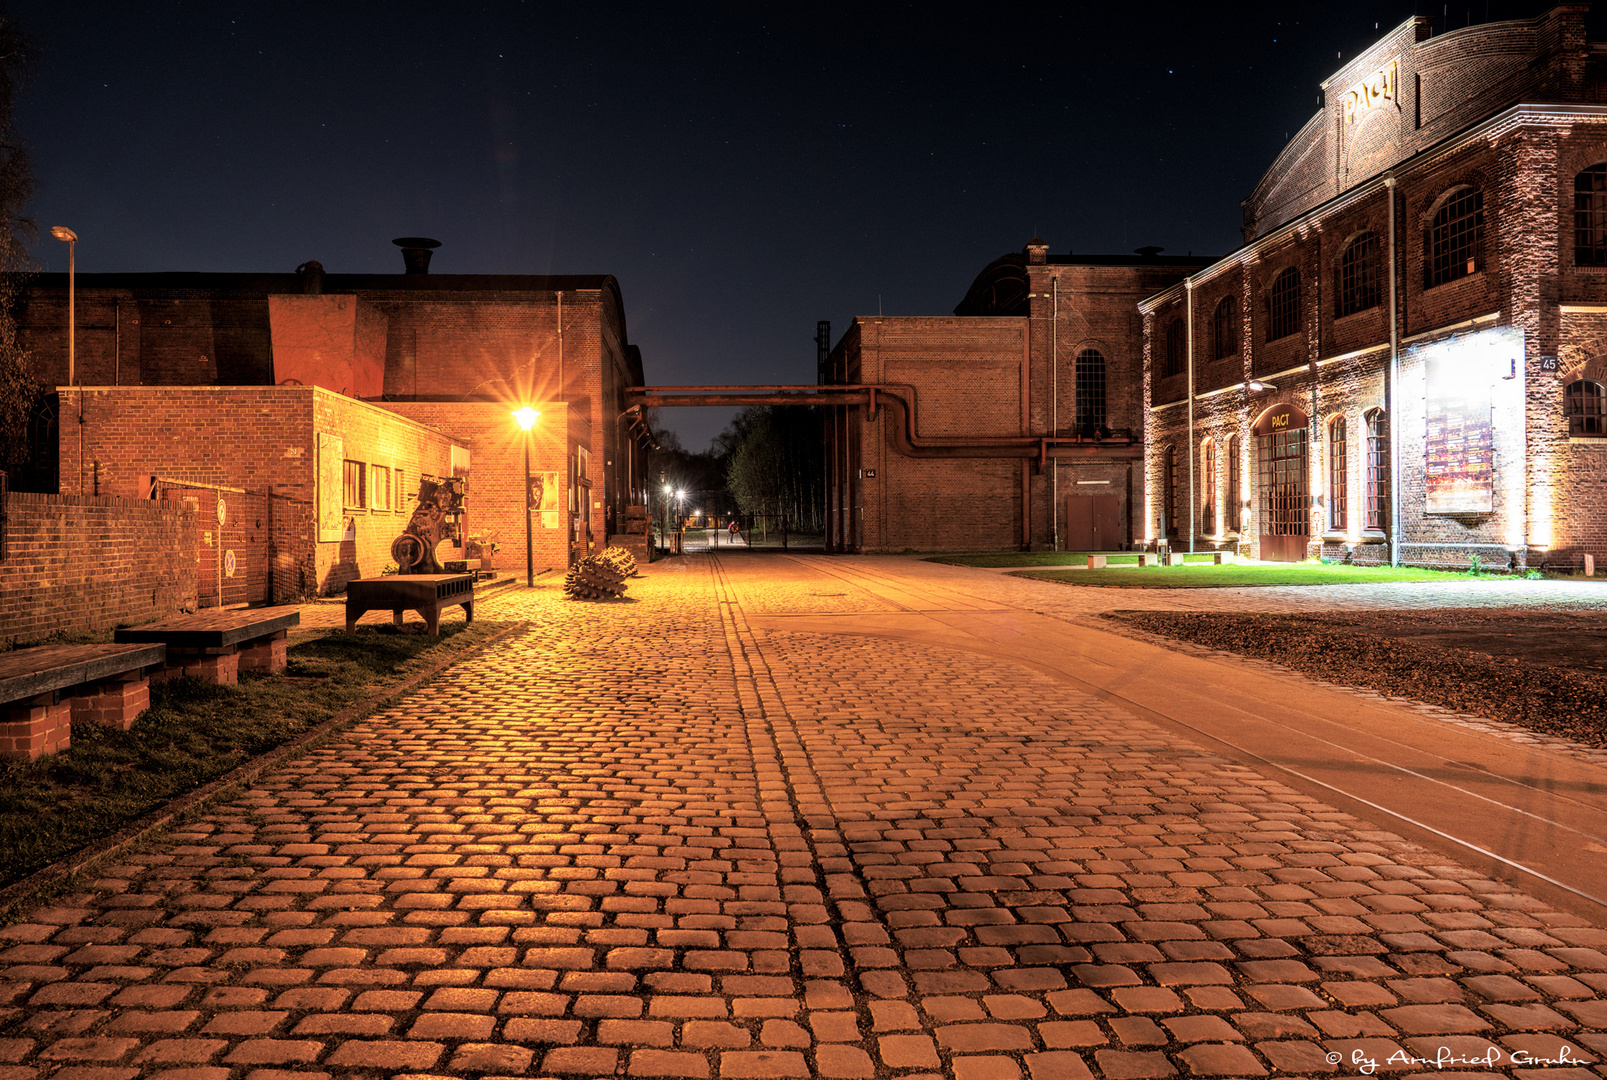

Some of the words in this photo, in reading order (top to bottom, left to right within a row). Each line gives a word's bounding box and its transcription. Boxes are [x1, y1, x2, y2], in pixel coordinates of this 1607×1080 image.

[1345, 63, 1397, 124] PACT
[1543, 359, 1556, 370] 45
[1272, 413, 1290, 428] PACT
